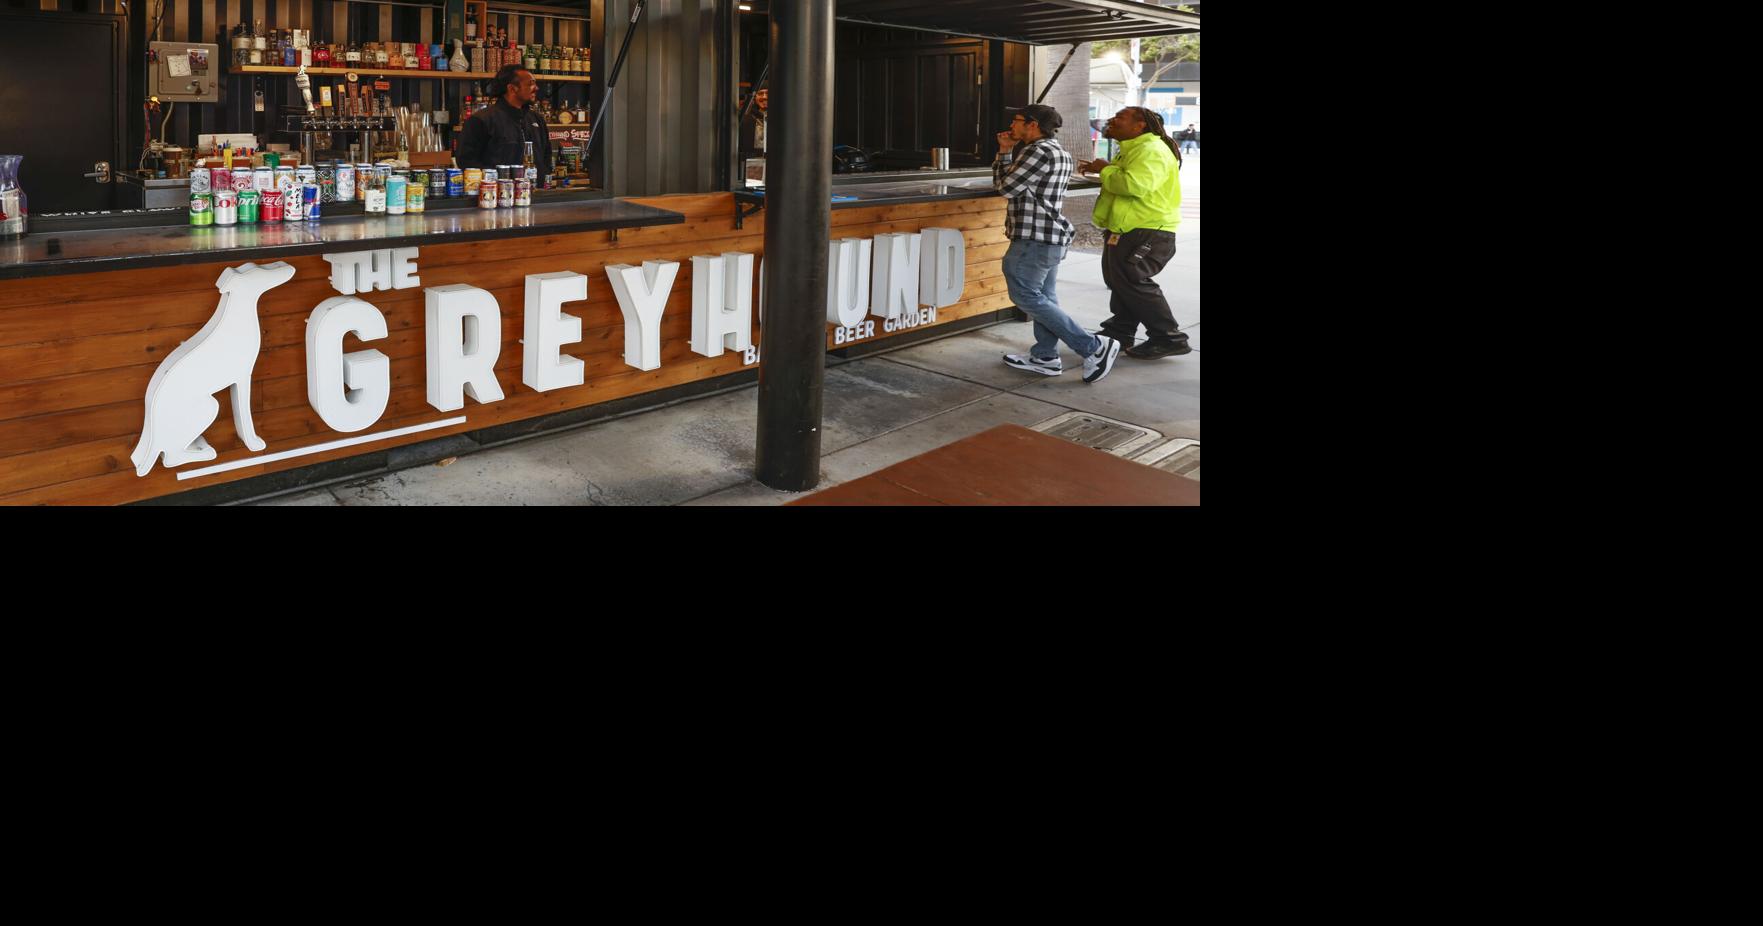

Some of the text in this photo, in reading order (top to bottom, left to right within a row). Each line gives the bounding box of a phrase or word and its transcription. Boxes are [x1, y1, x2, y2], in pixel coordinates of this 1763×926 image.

[322, 246, 421, 295] THE
[305, 227, 966, 432] GREYHUND
[834, 320, 875, 345] BEER
[882, 306, 937, 333] GARDEN
